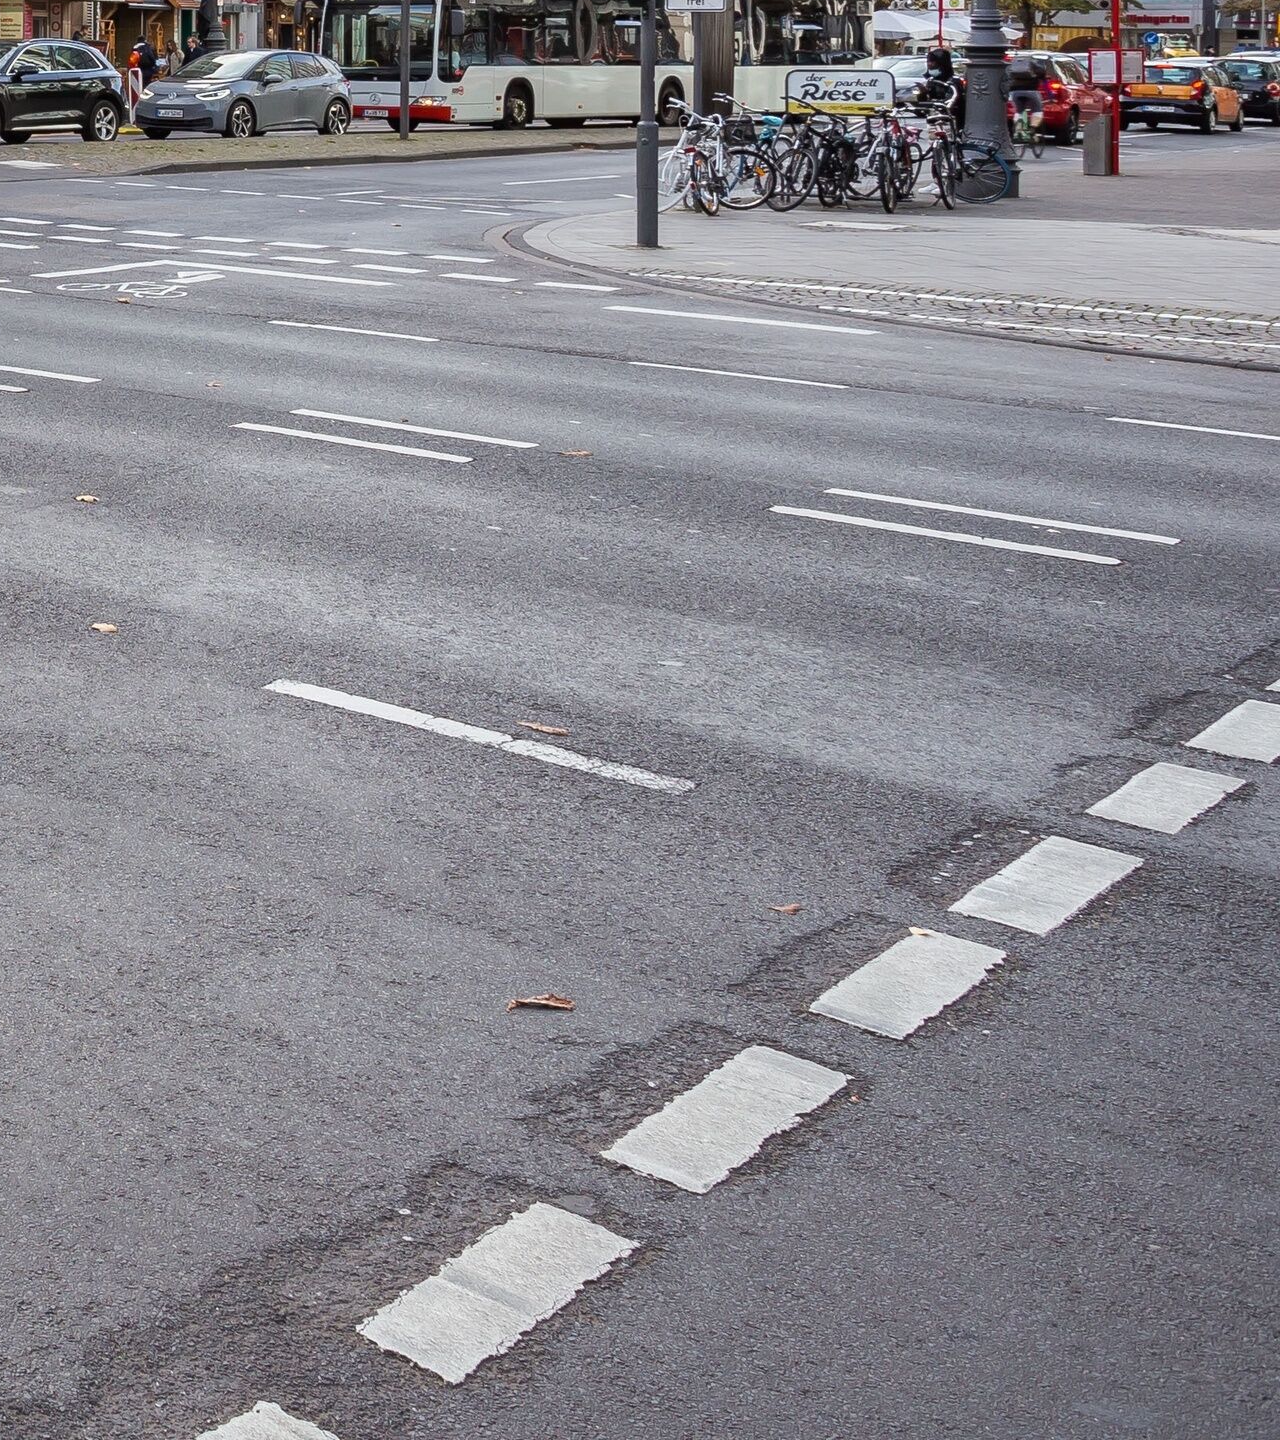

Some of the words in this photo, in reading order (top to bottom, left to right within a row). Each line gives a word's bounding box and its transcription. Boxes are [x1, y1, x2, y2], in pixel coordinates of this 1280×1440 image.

[806, 73, 826, 82] der
[834, 78, 880, 89] parkett
[800, 83, 867, 102] Riese
